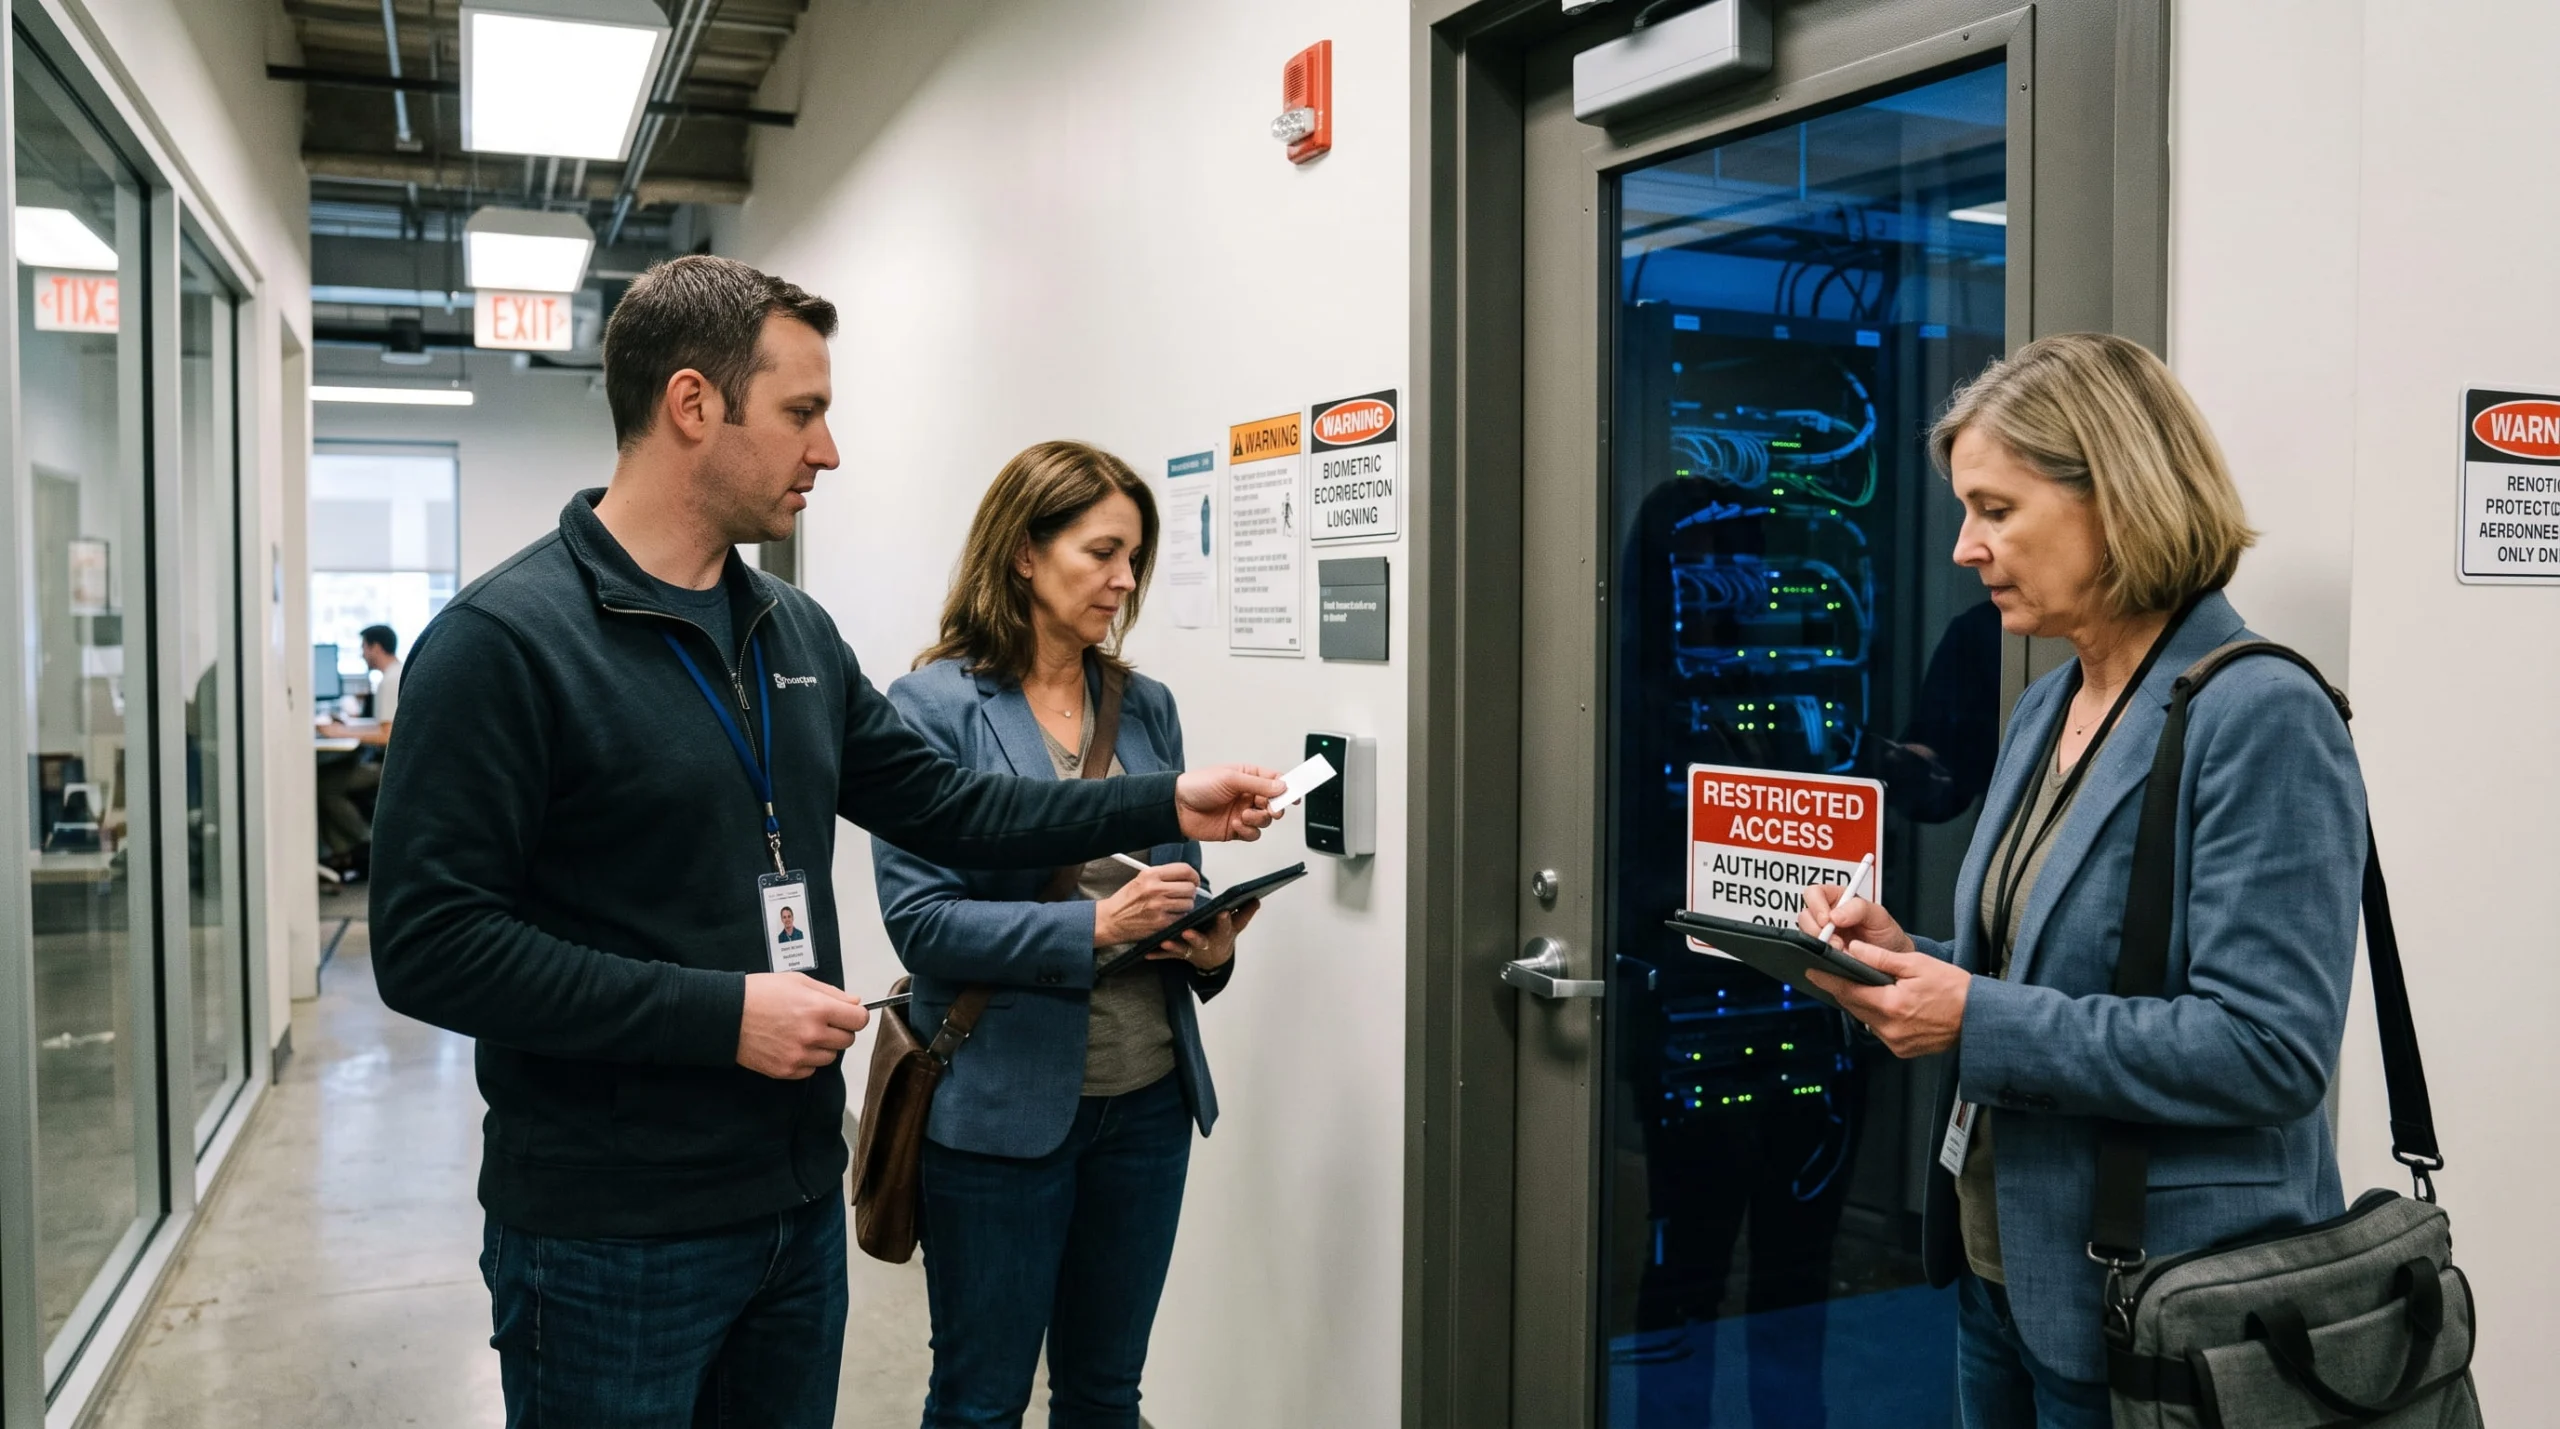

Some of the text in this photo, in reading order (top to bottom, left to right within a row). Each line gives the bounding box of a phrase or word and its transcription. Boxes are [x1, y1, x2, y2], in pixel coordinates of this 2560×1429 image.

[492, 295, 557, 341] EXIT
[1322, 406, 1384, 437] WARNING
[2490, 412, 2560, 445] WARN
[1245, 424, 1298, 453] WARNING
[1323, 454, 1382, 479] BIOMETRIC
[2497, 546, 2560, 563] ONLY DN
[1703, 780, 1864, 821] RESTRICTED
[1729, 815, 1834, 851] ACCESS
[1712, 853, 1851, 887] AUTHORIZED
[1712, 880, 1808, 913] PERSON
